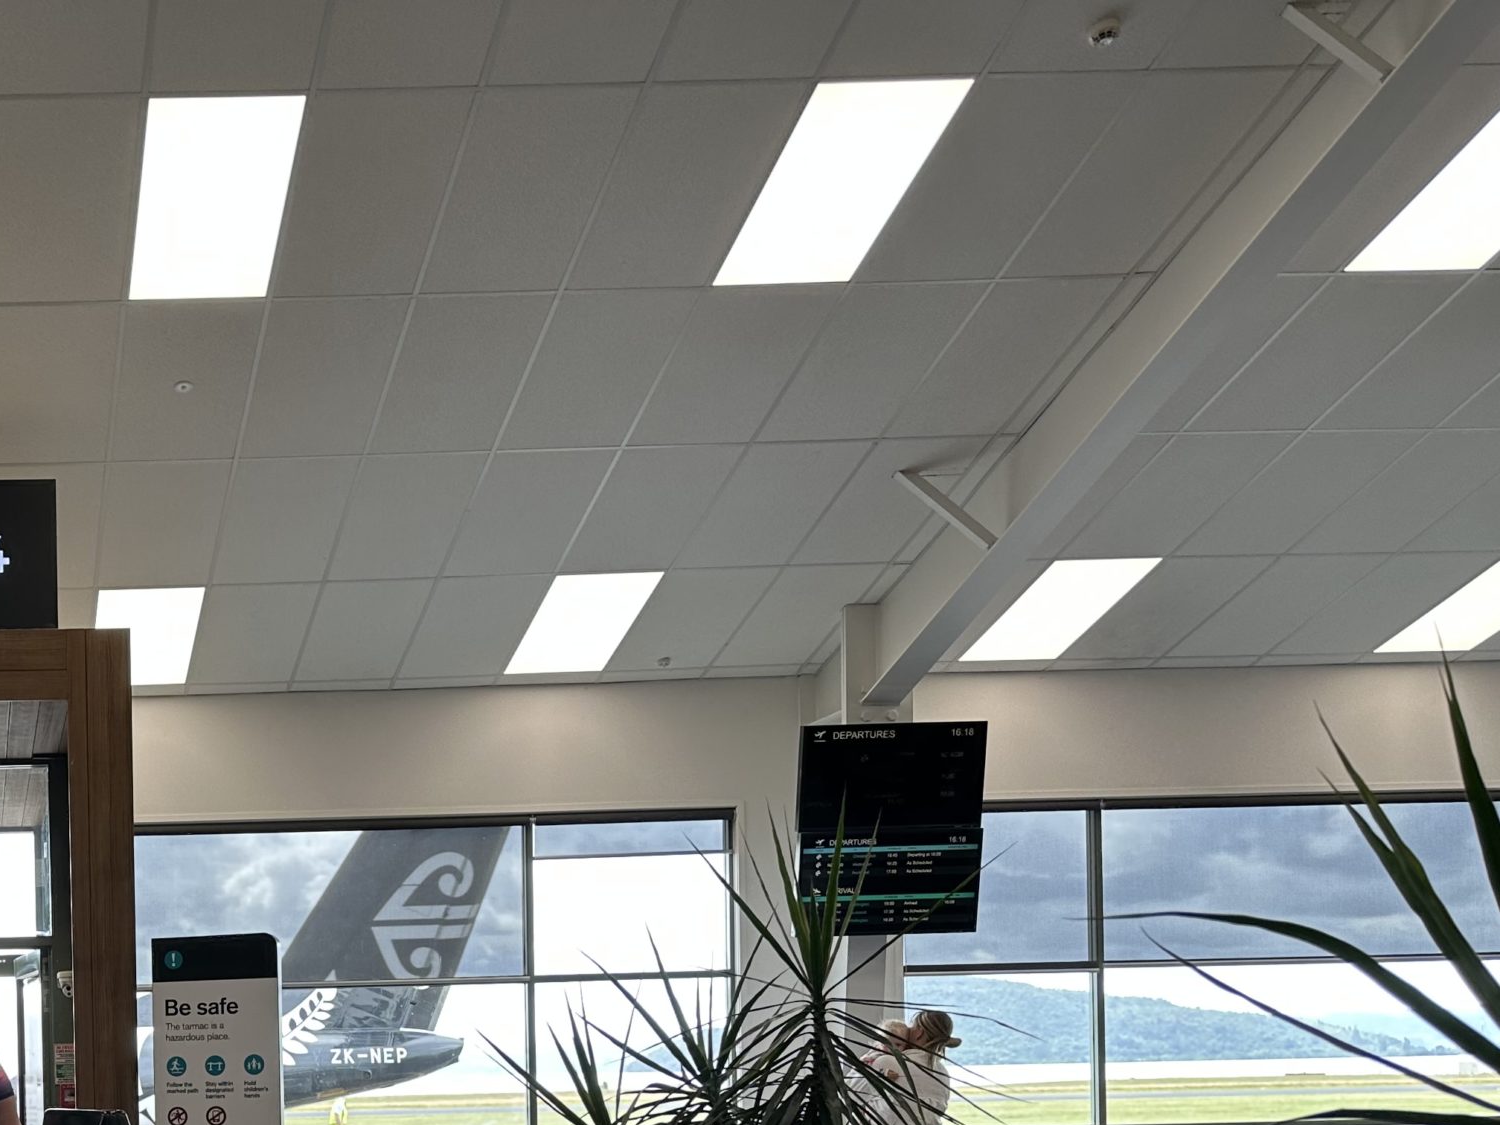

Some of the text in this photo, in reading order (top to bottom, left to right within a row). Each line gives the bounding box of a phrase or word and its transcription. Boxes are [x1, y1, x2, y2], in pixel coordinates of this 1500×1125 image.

[832, 730, 896, 740] DEPARTURES
[164, 997, 239, 1017] Be safe
[165, 1022, 180, 1031] The
[182, 1022, 209, 1031] tarmac
[210, 1022, 218, 1030] is
[165, 1033, 230, 1043] hazardous place.
[329, 1047, 408, 1065] ZK-NEP
